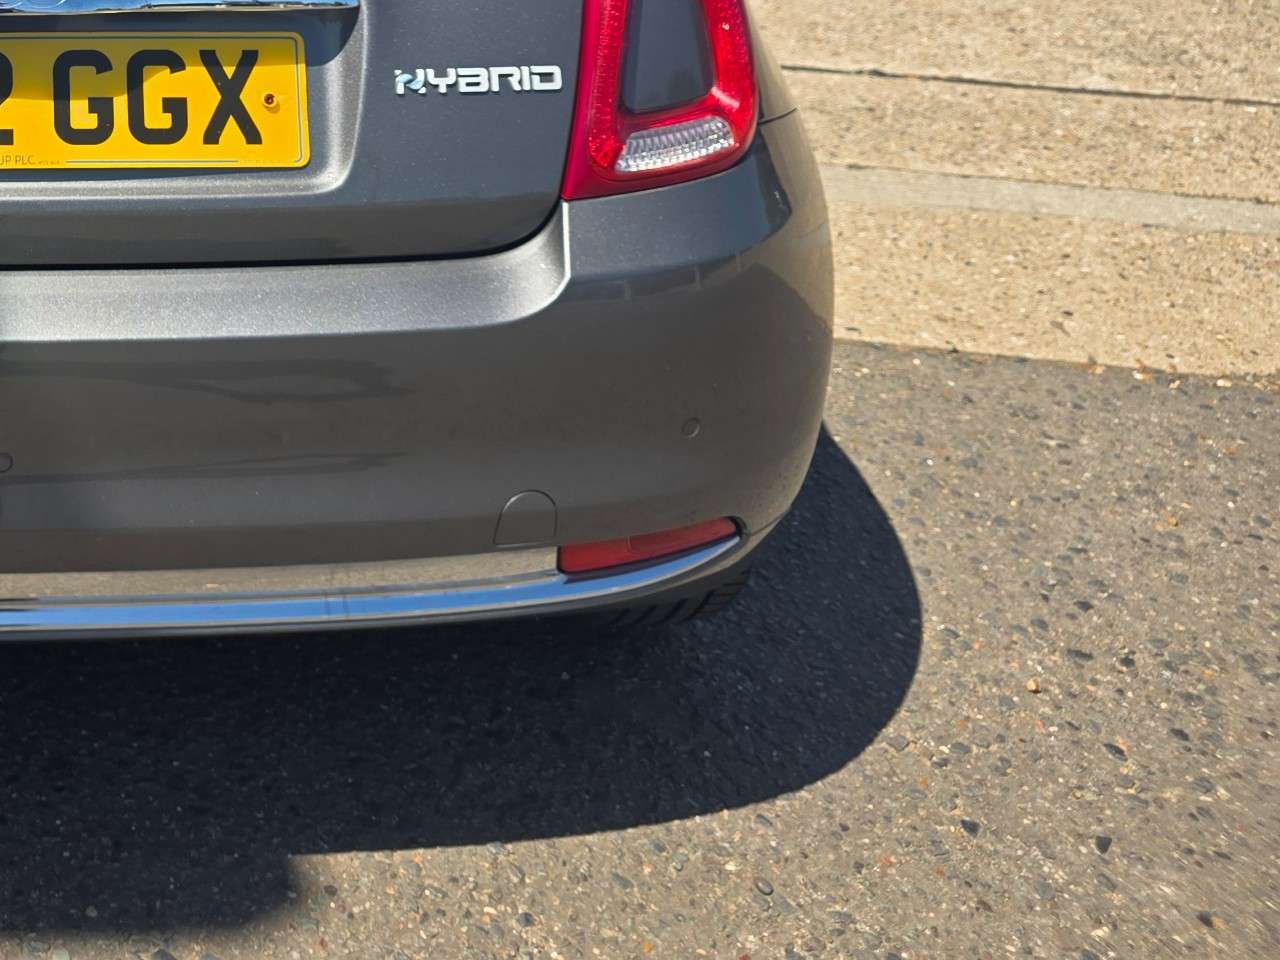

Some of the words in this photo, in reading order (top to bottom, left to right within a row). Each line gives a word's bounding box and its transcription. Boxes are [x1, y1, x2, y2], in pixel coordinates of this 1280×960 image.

[394, 65, 562, 95] HYBRID
[52, 49, 263, 146] GGX
[15, 154, 36, 165] PLC
